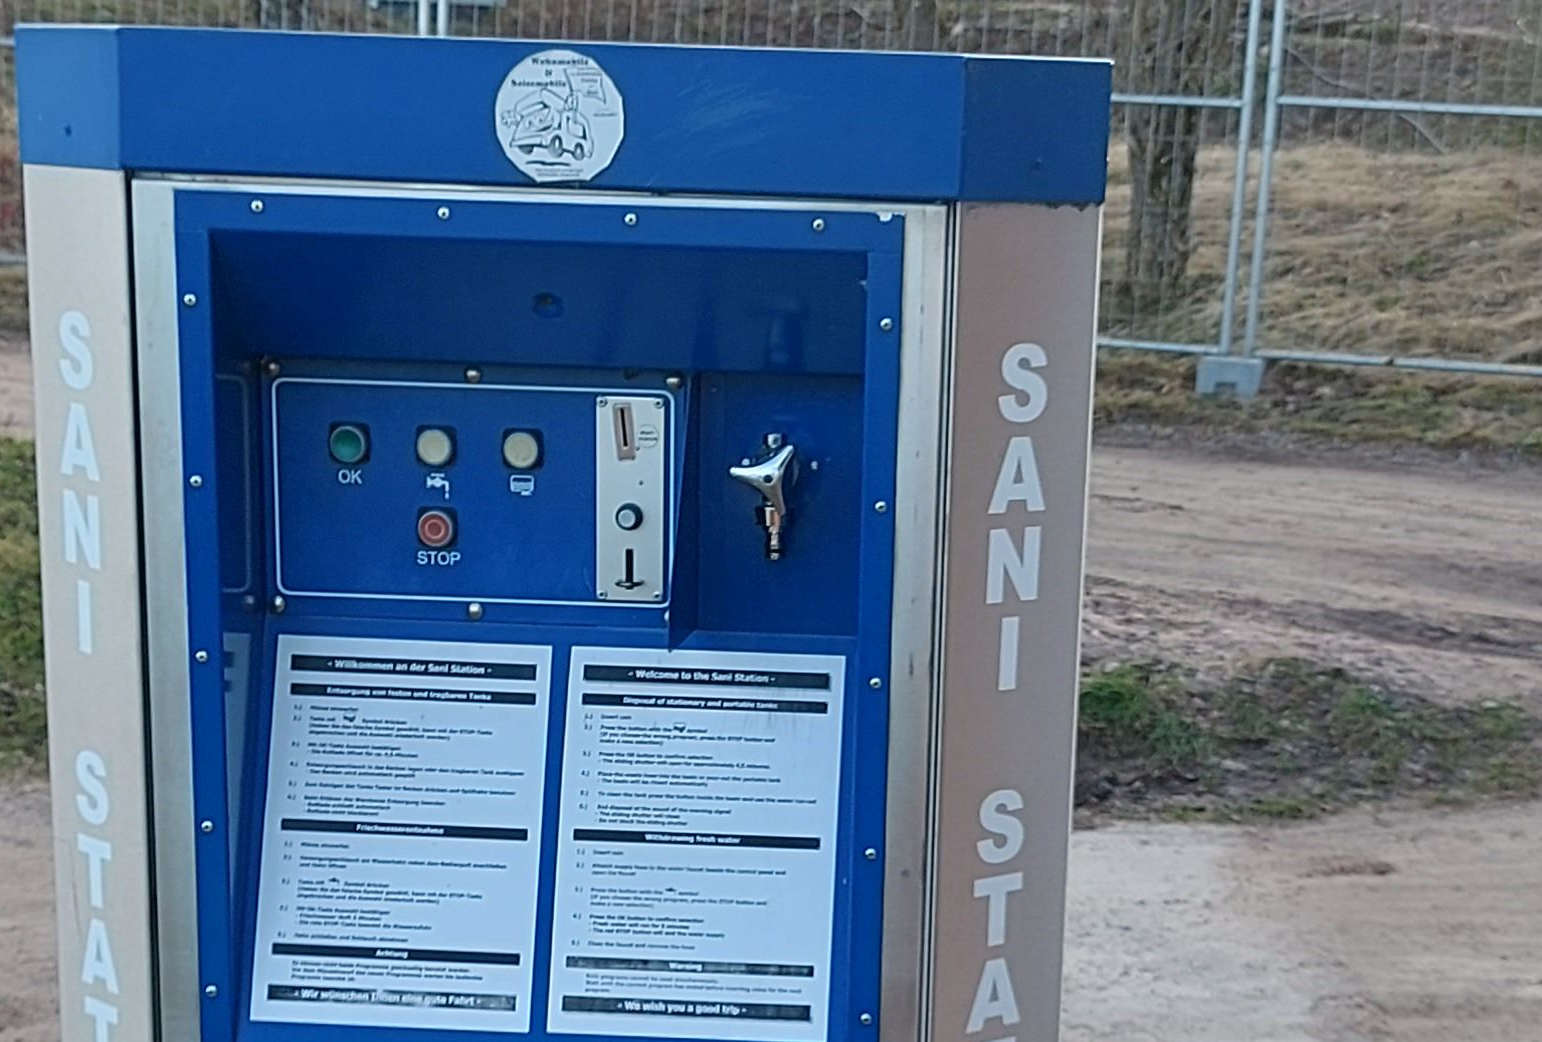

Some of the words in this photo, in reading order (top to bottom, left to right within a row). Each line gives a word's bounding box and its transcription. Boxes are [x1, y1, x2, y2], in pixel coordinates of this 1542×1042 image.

[59, 311, 101, 655] SANI
[338, 469, 363, 485] OK
[416, 550, 461, 567] STOP
[986, 342, 1049, 692] SANI
